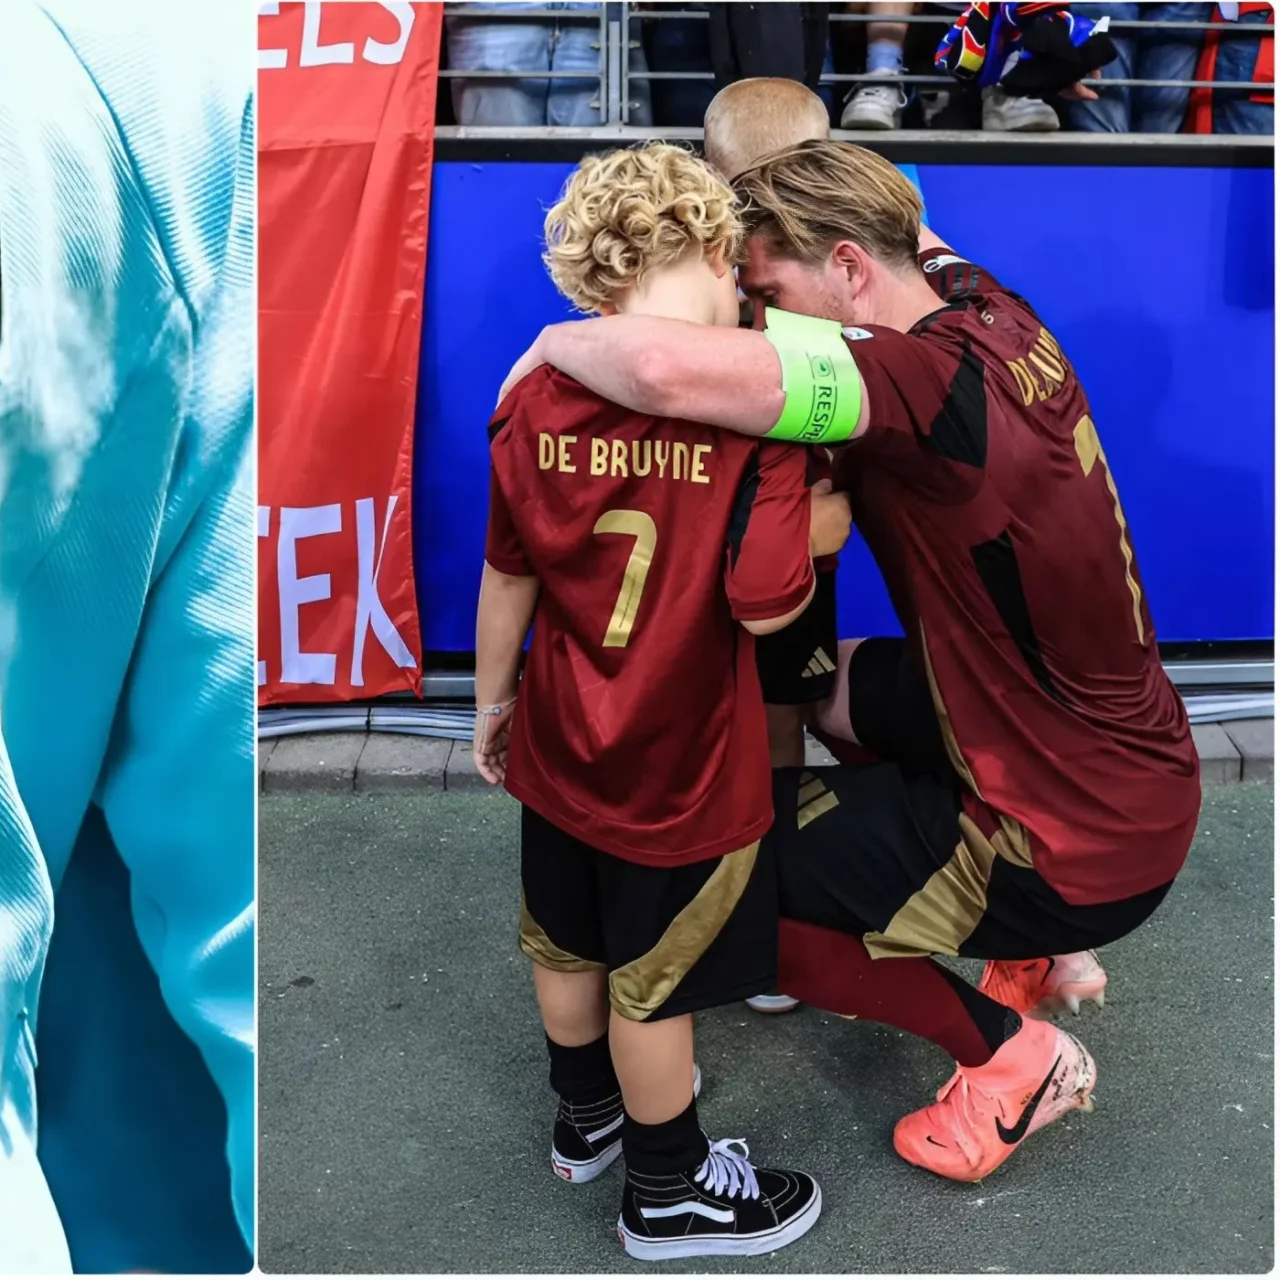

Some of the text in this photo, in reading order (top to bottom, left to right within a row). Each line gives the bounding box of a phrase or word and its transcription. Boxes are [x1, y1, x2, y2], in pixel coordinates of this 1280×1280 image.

[538, 432, 713, 484] DE BRUYNE
[257, 496, 418, 687] EK
[593, 509, 658, 648] 7
